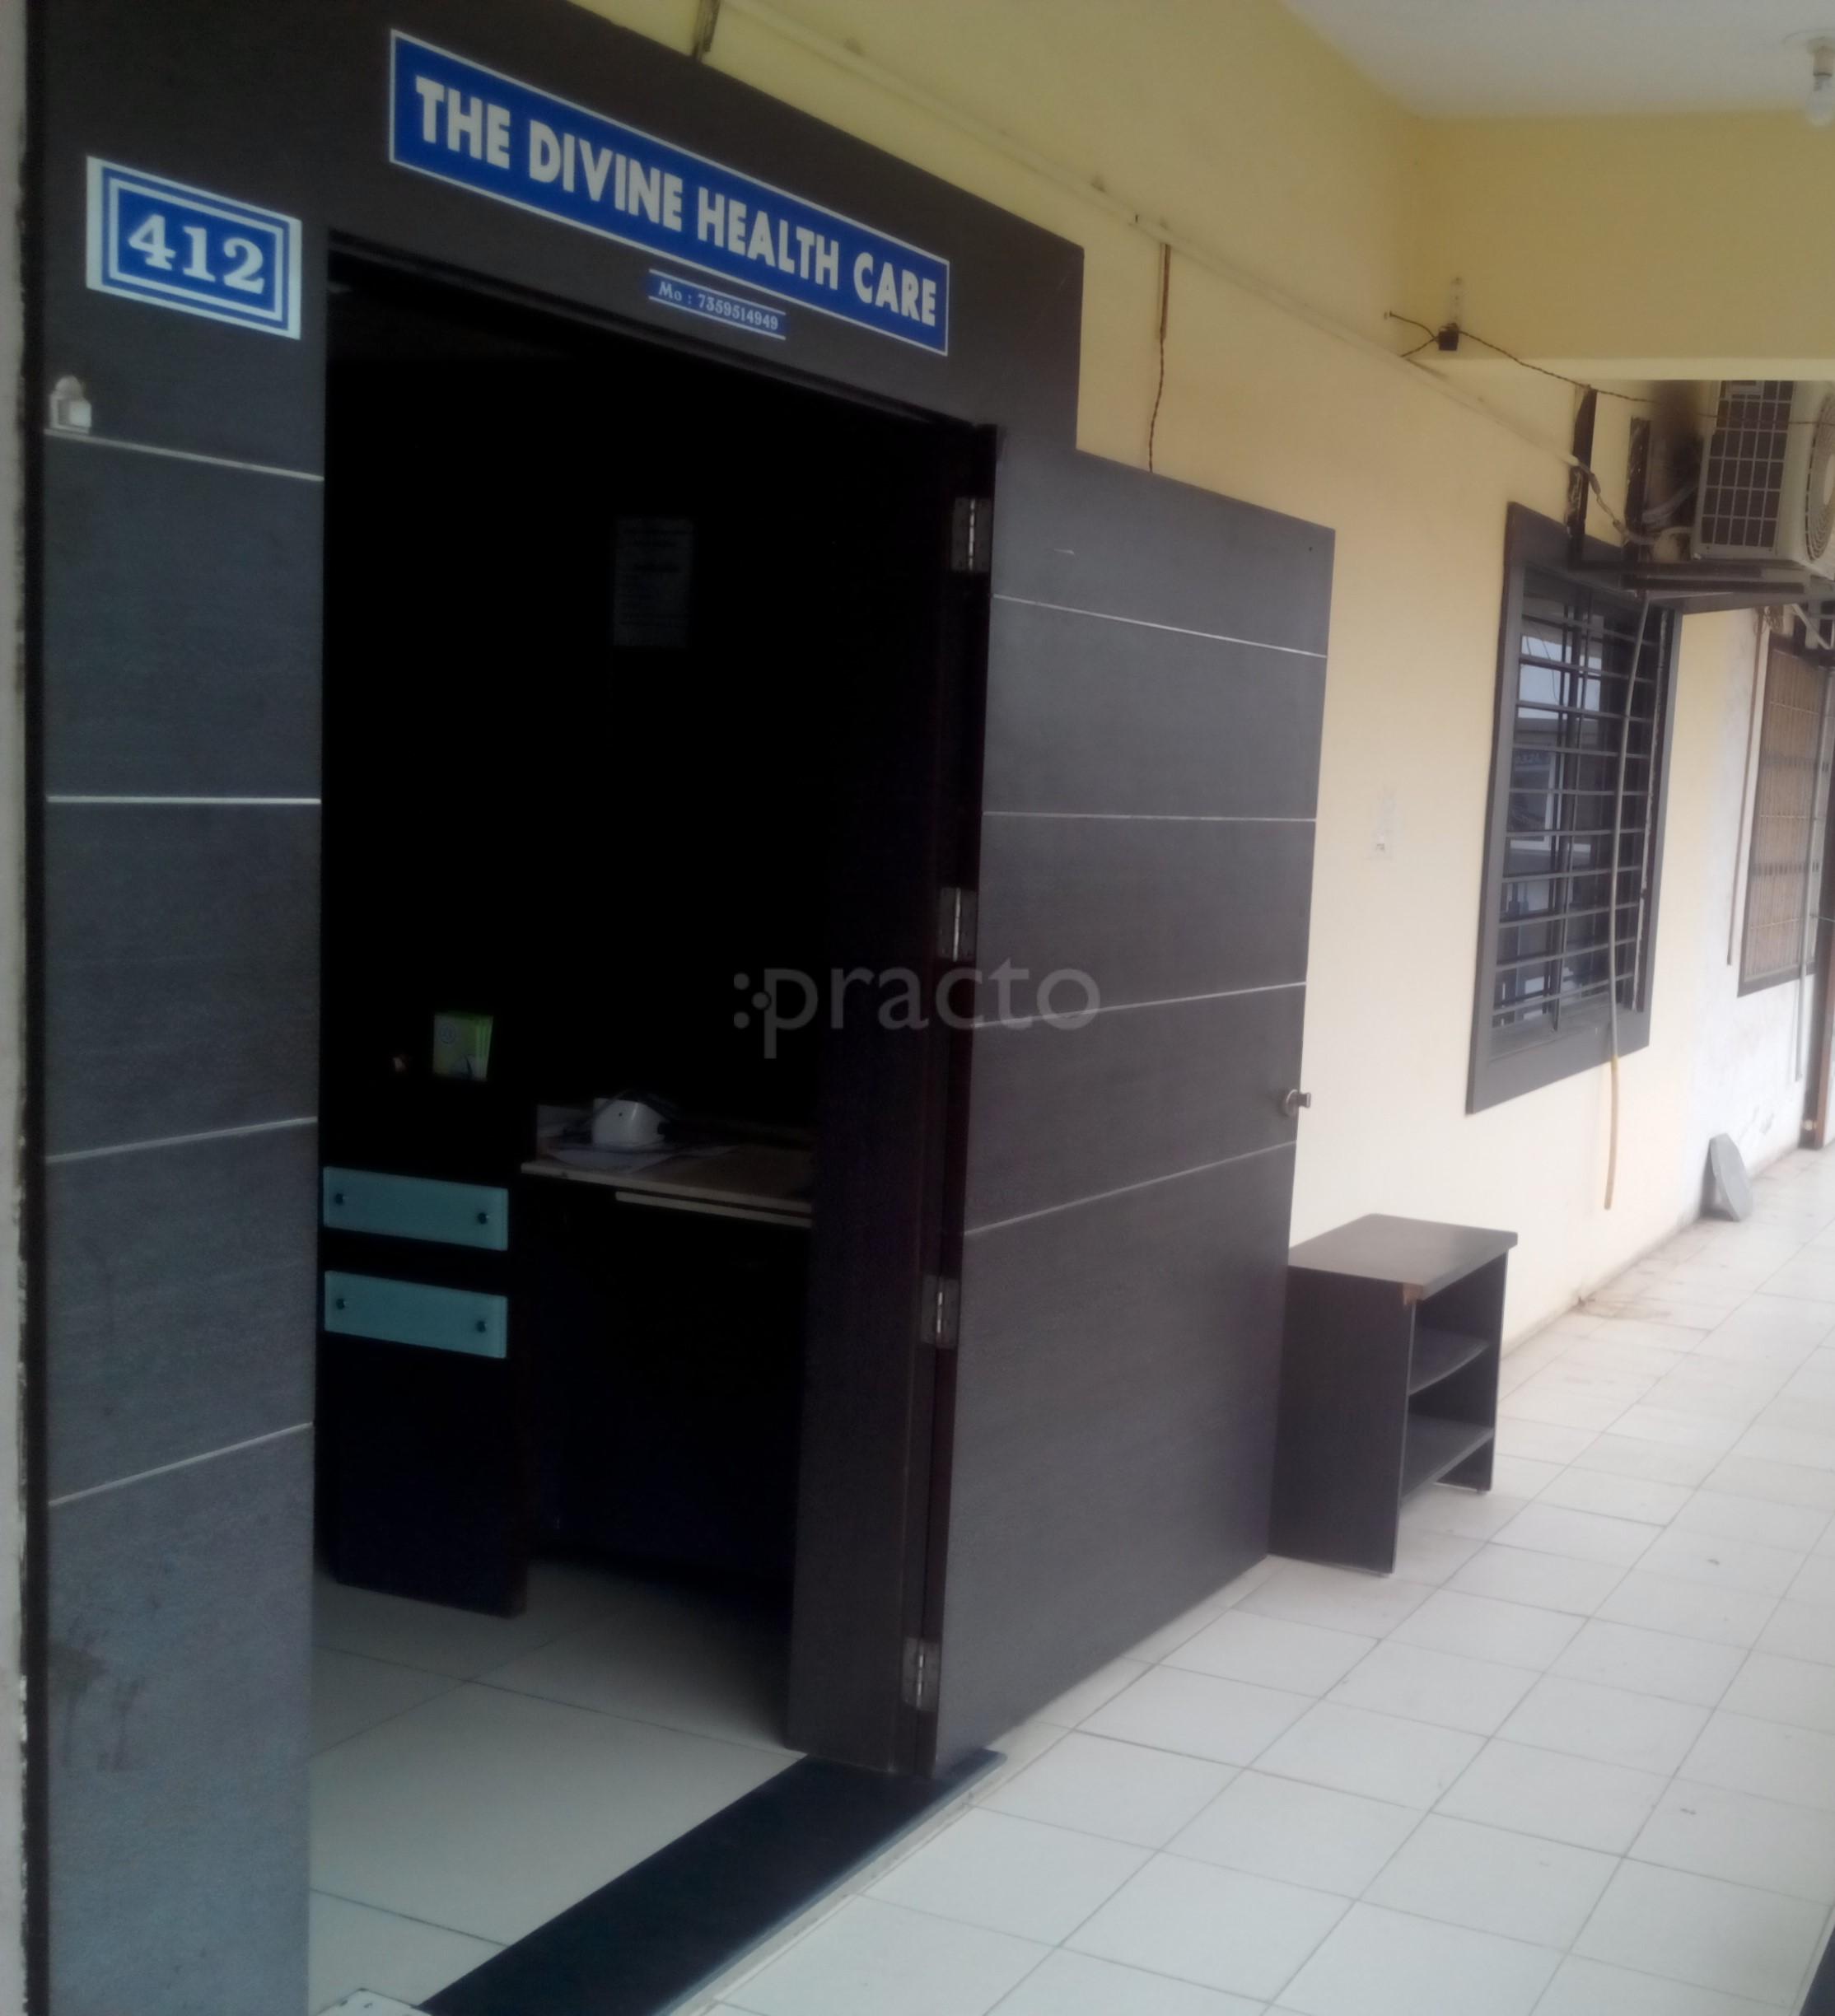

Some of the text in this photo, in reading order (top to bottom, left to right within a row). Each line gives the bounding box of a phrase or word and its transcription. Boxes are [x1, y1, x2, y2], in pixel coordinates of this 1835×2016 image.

[416, 76, 936, 326] THE DIVINE HEALTH CARE
[128, 213, 264, 294] 412
[659, 282, 682, 301] Mo
[698, 294, 778, 330] 7359514949
